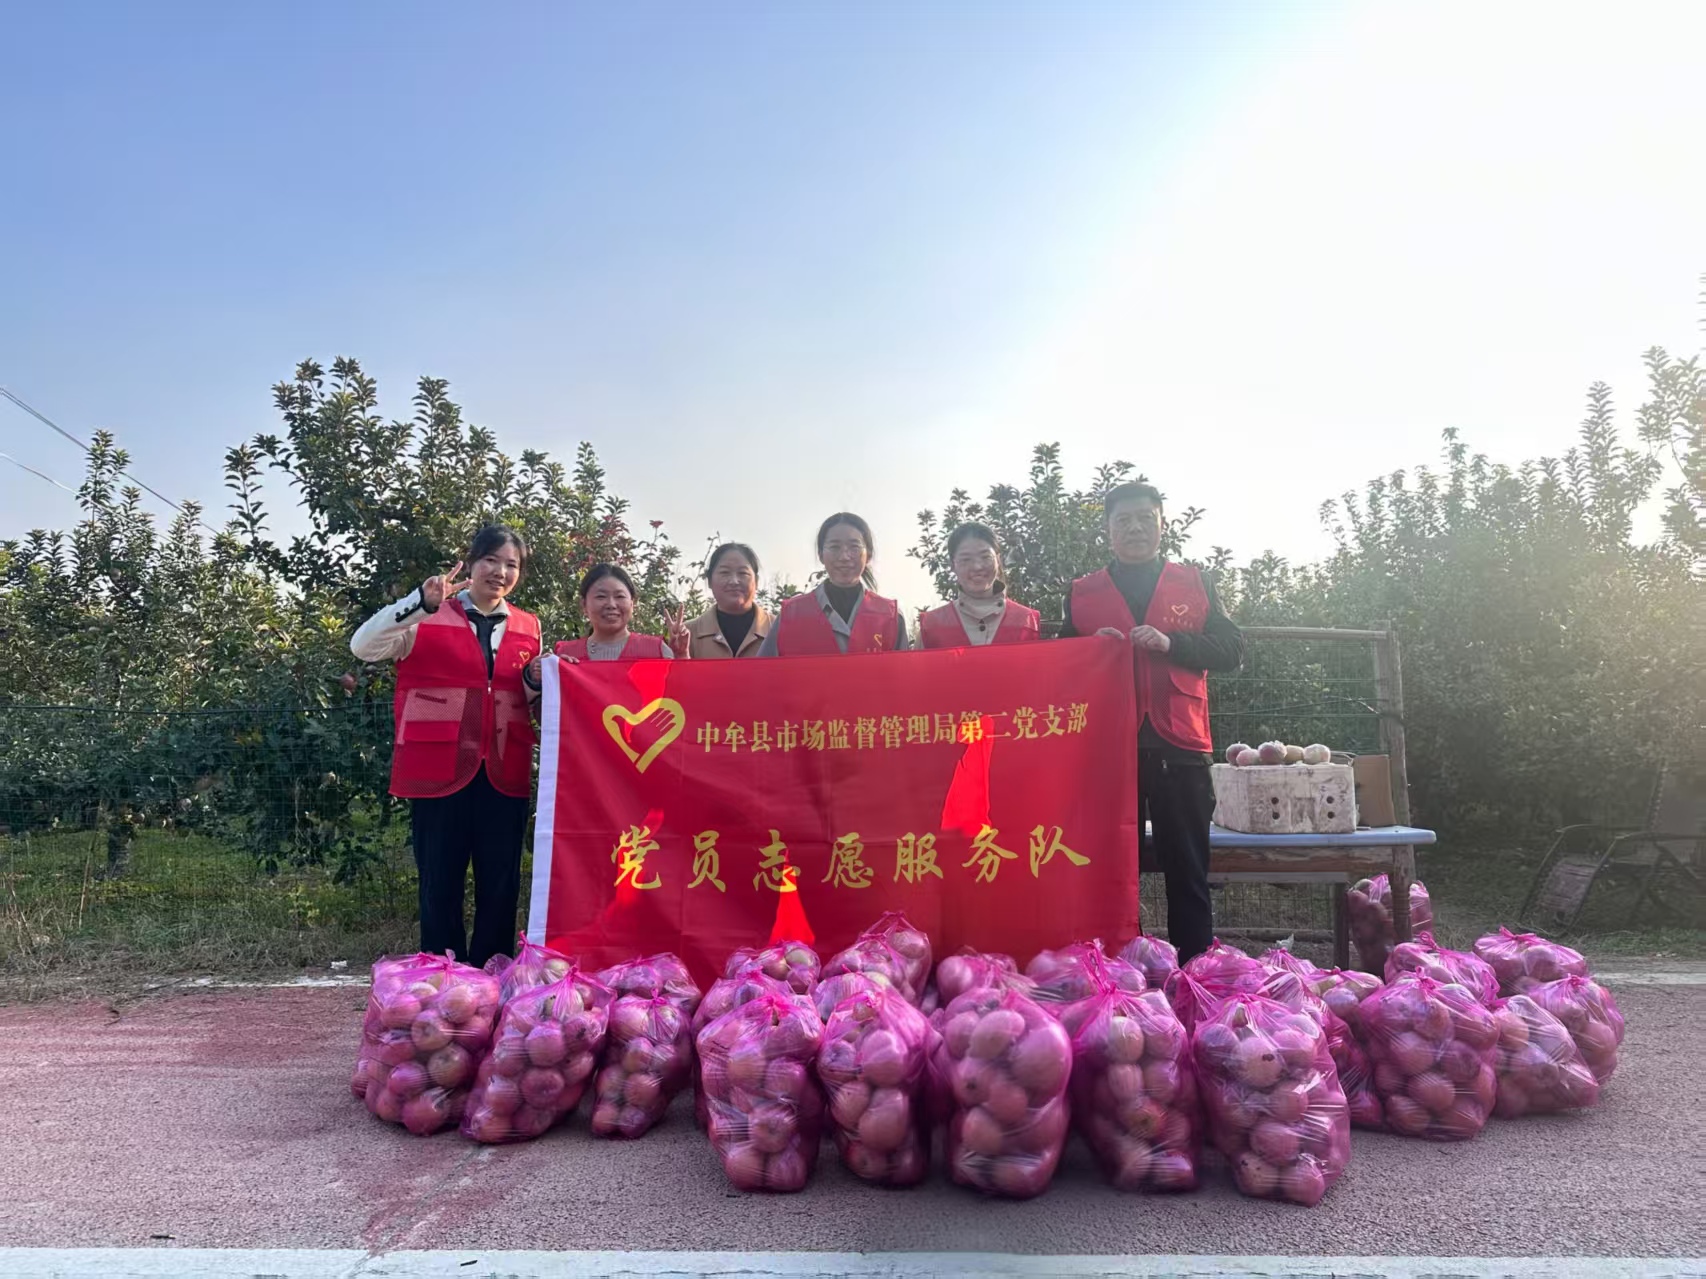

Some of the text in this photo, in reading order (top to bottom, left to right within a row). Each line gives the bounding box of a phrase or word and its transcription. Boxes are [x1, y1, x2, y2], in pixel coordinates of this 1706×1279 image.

[697, 702, 1089, 753] 中牟县市场监督管理局第二党支部
[610, 824, 1091, 893] 党员志愿服务队
